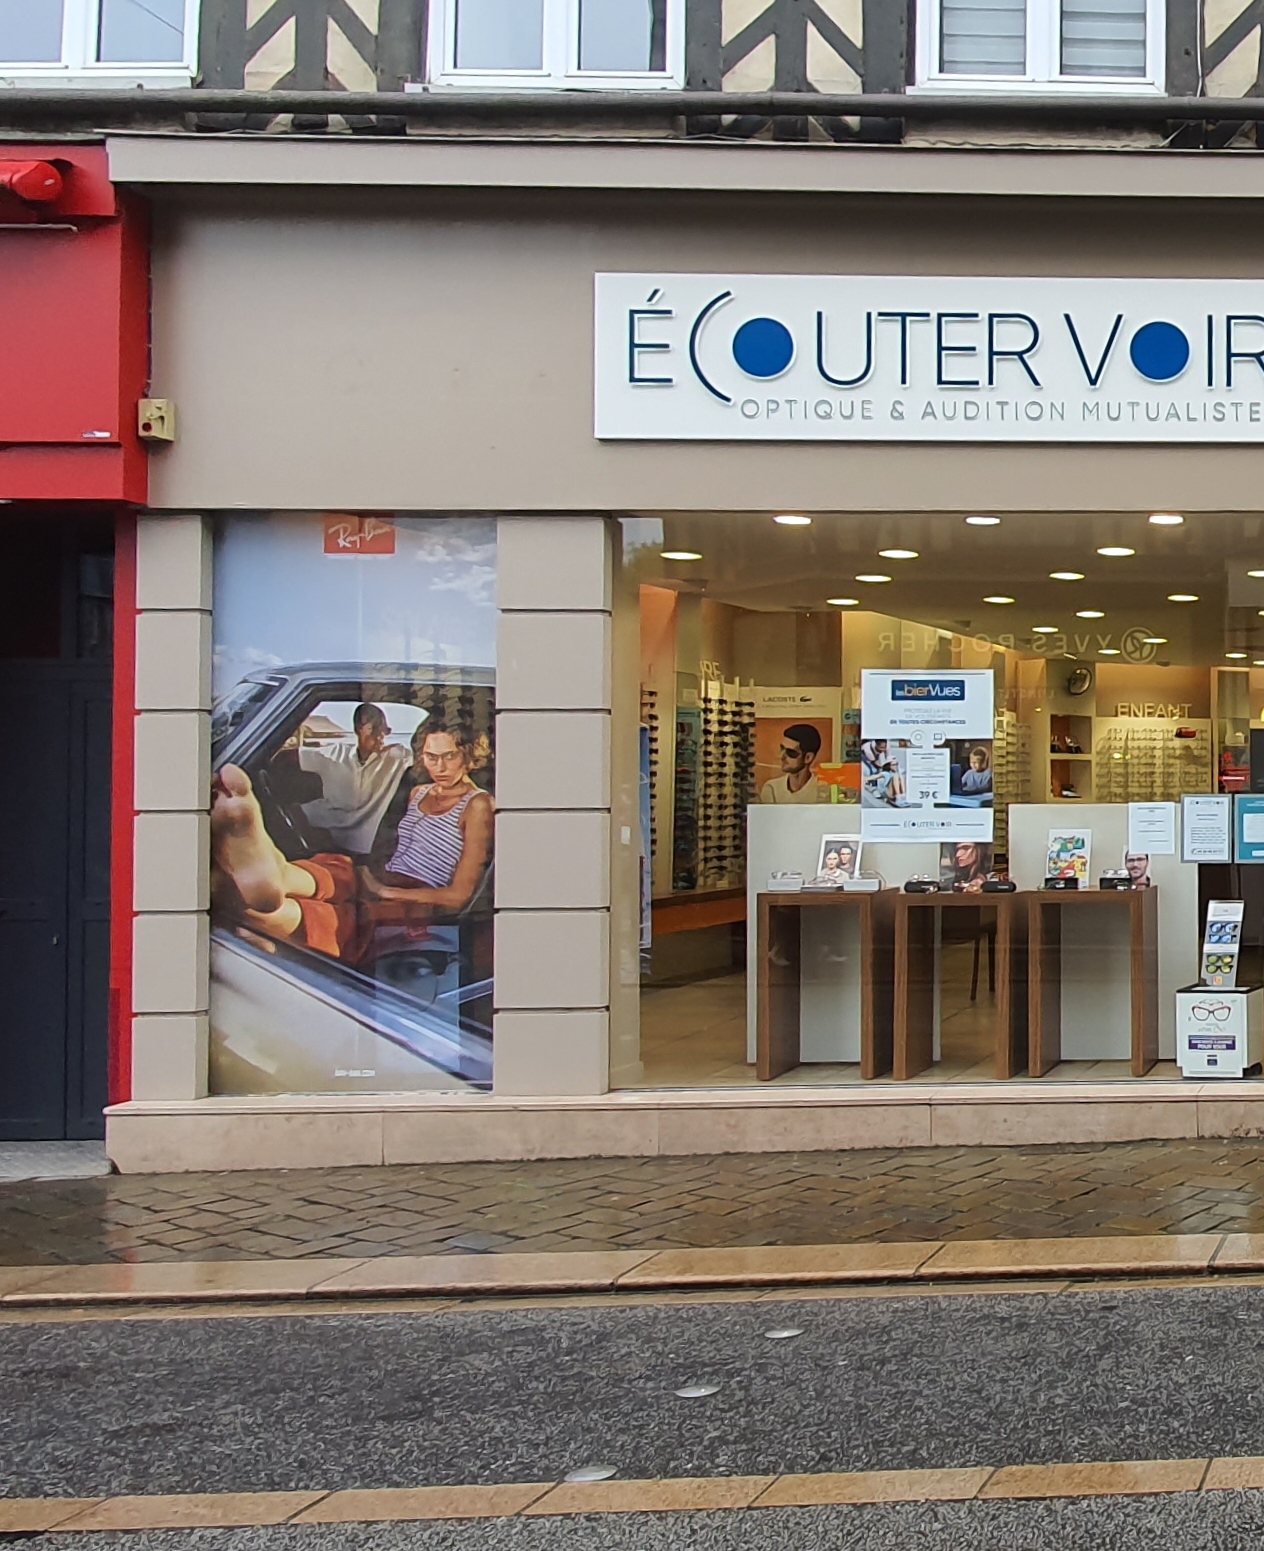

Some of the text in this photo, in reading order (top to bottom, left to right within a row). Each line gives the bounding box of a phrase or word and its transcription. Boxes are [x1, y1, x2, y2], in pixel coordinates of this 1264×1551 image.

[740, 399, 873, 421] OPTIQUE
[889, 400, 906, 421] &
[921, 400, 1066, 422] AUDITION
[1117, 702, 1193, 719] ENFANT
[919, 791, 930, 799] 39
